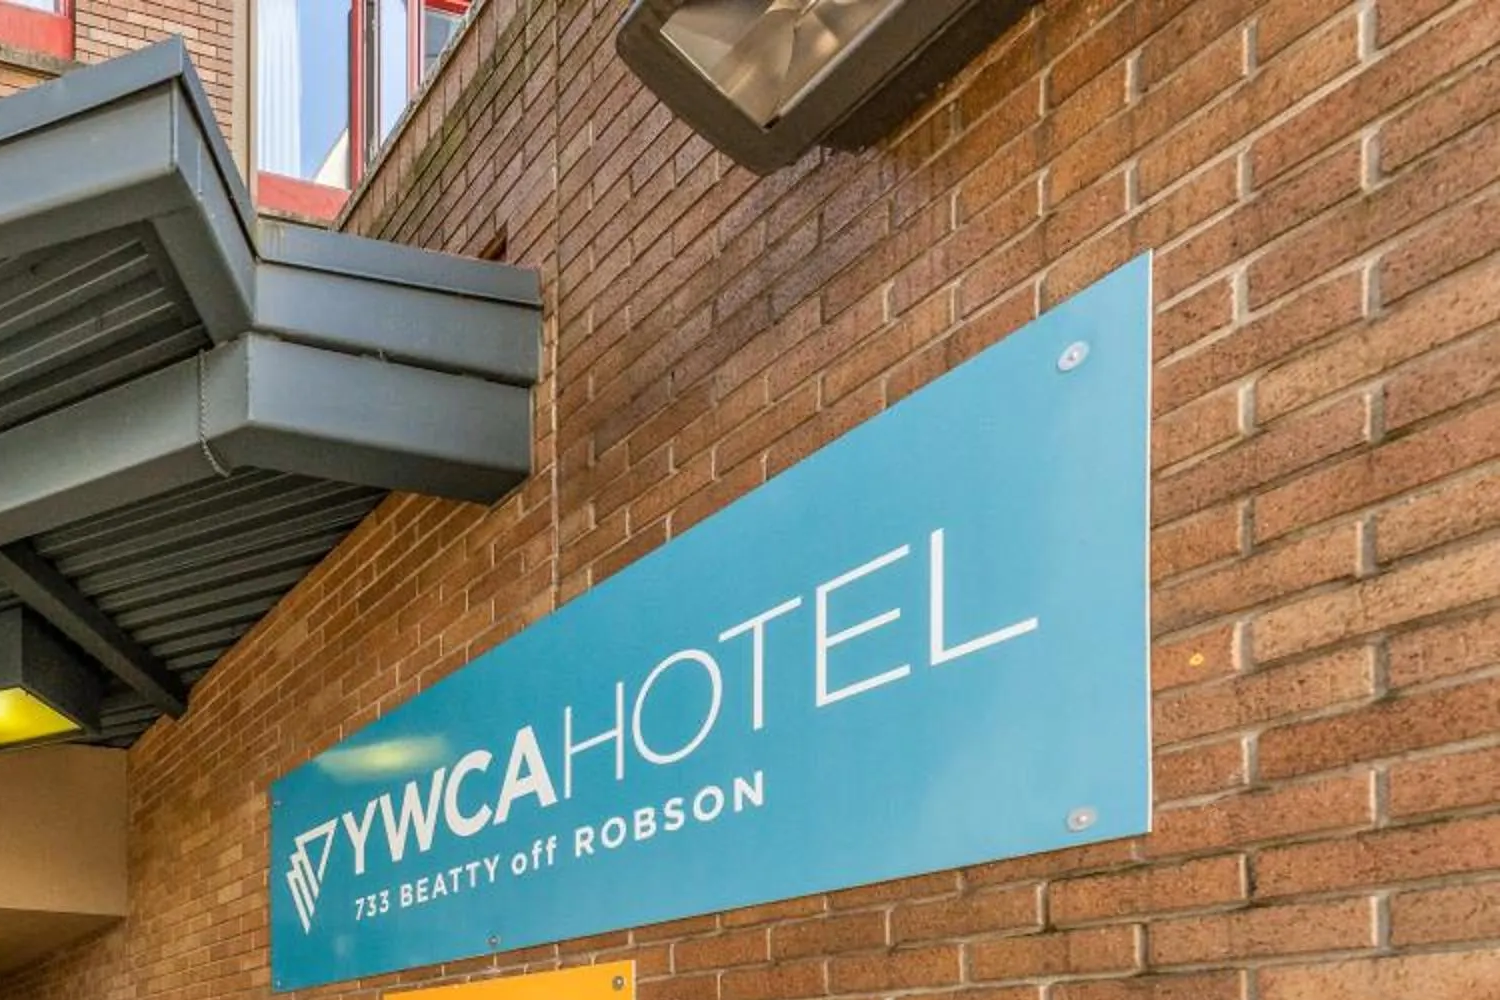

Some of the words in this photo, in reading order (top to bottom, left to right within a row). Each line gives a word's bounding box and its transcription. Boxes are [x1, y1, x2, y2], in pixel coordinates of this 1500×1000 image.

[355, 889, 390, 921] 733
[400, 854, 501, 908] BEATTY
[510, 835, 558, 876] off
[573, 769, 765, 858] ROBSON
